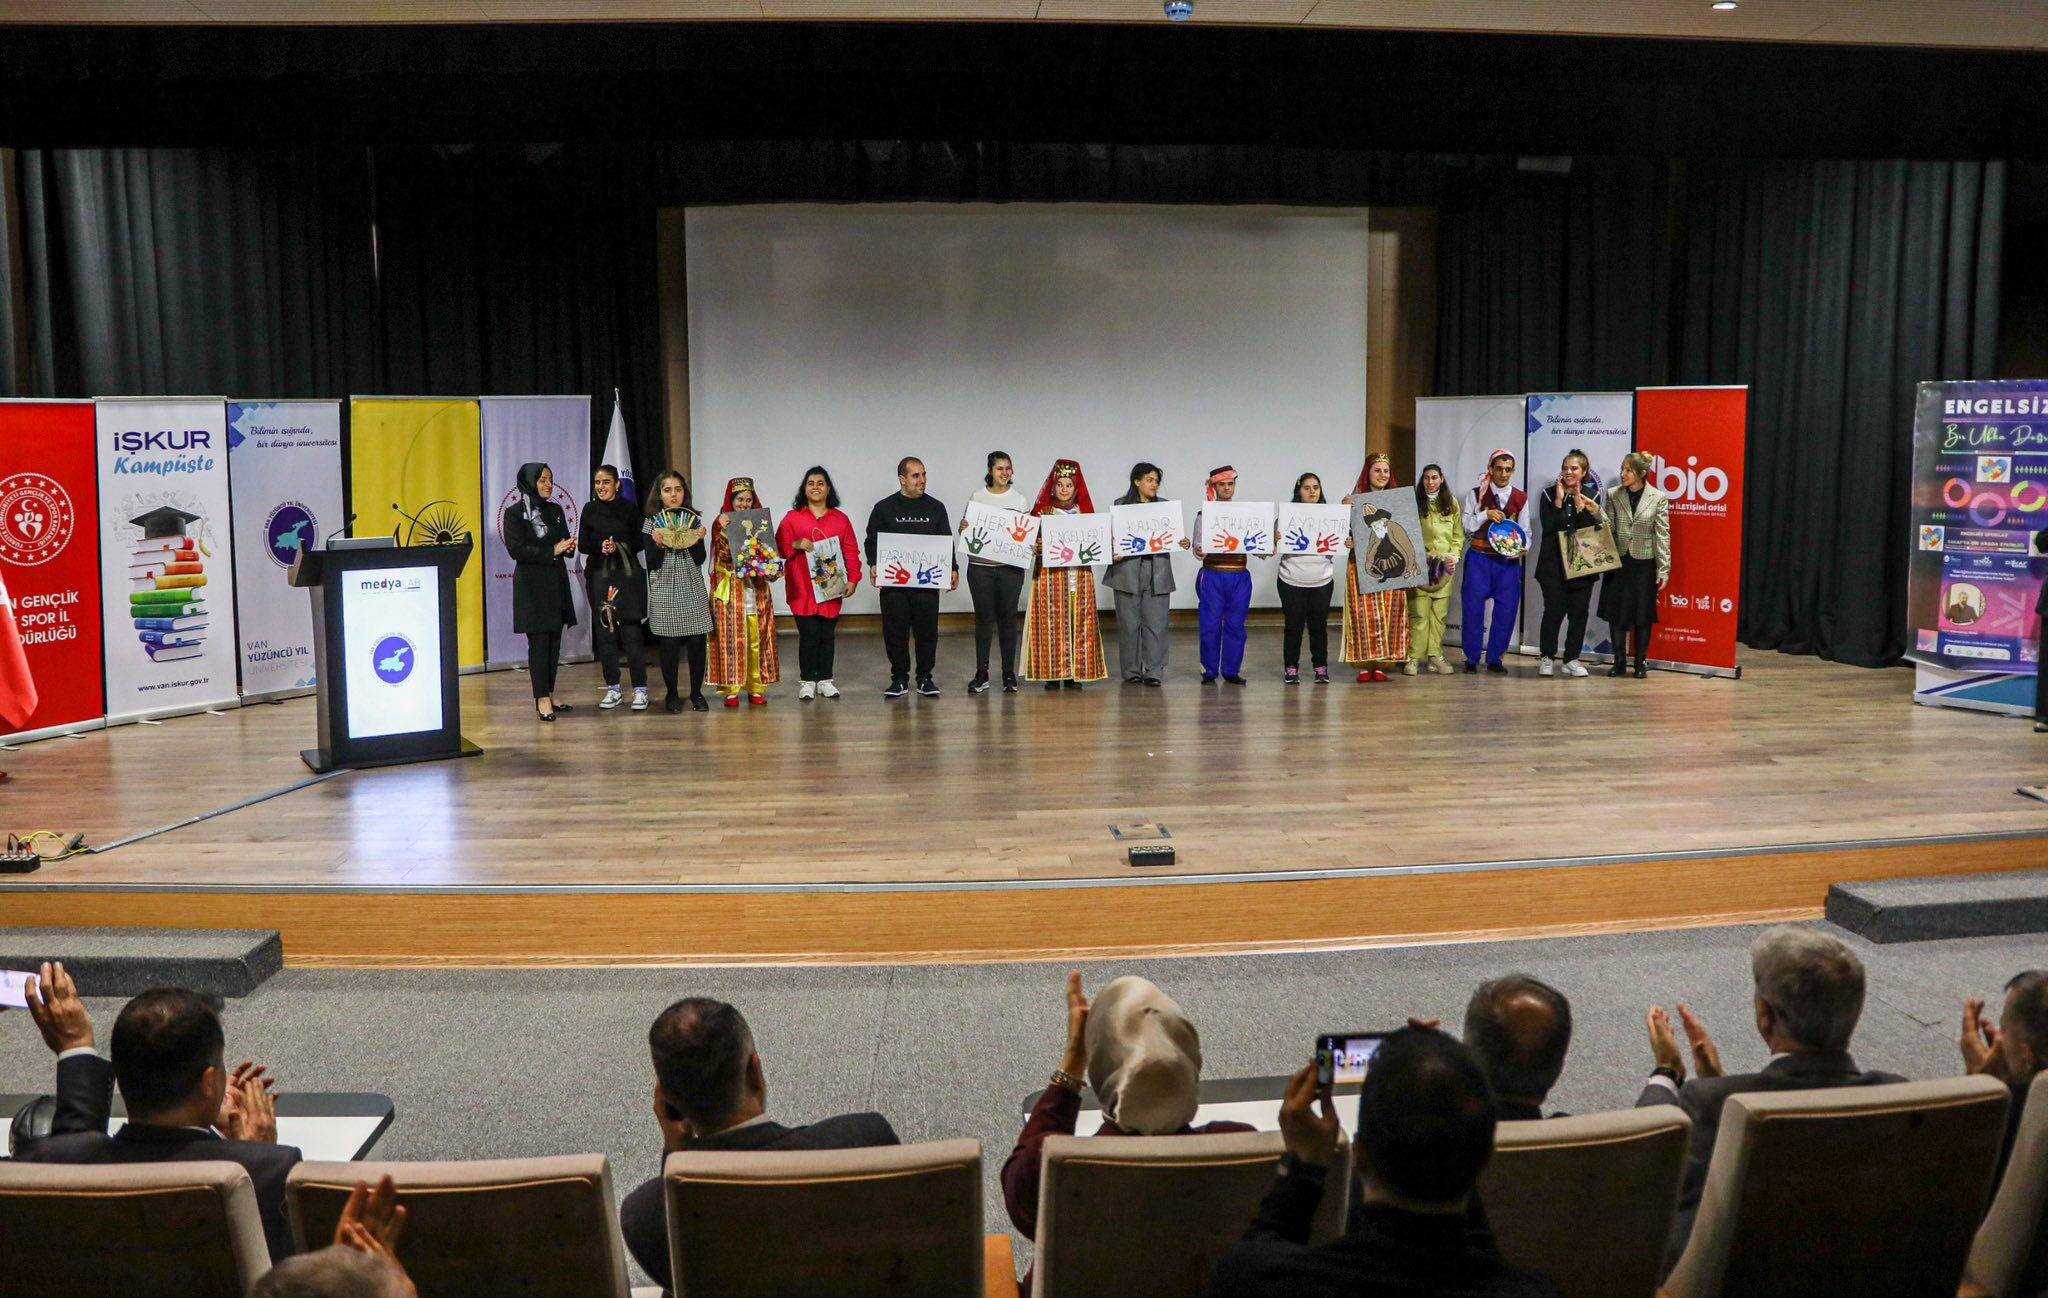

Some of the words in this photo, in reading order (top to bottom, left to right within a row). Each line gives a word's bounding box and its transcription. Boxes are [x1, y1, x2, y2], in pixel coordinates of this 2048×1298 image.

[1945, 396, 2048, 414] ENGELSİZ
[250, 426, 278, 435] Bilimin
[114, 454, 214, 477] Kampüste
[1656, 455, 1729, 501] bio
[1708, 504, 1727, 512] OFİSİ
[976, 512, 1007, 533] HER
[993, 539, 1033, 560] YERDE
[21, 590, 79, 608] GENÇLİK
[21, 612, 56, 627] SPOR
[59, 608, 70, 622] İL
[19, 625, 77, 645] DÜRLÜĞÜ
[247, 640, 268, 650] VAN
[248, 646, 293, 662] YÜZÜNCÜ
[295, 647, 309, 655] YIL
[138, 678, 208, 691] www.van.iskur.gov.tr
